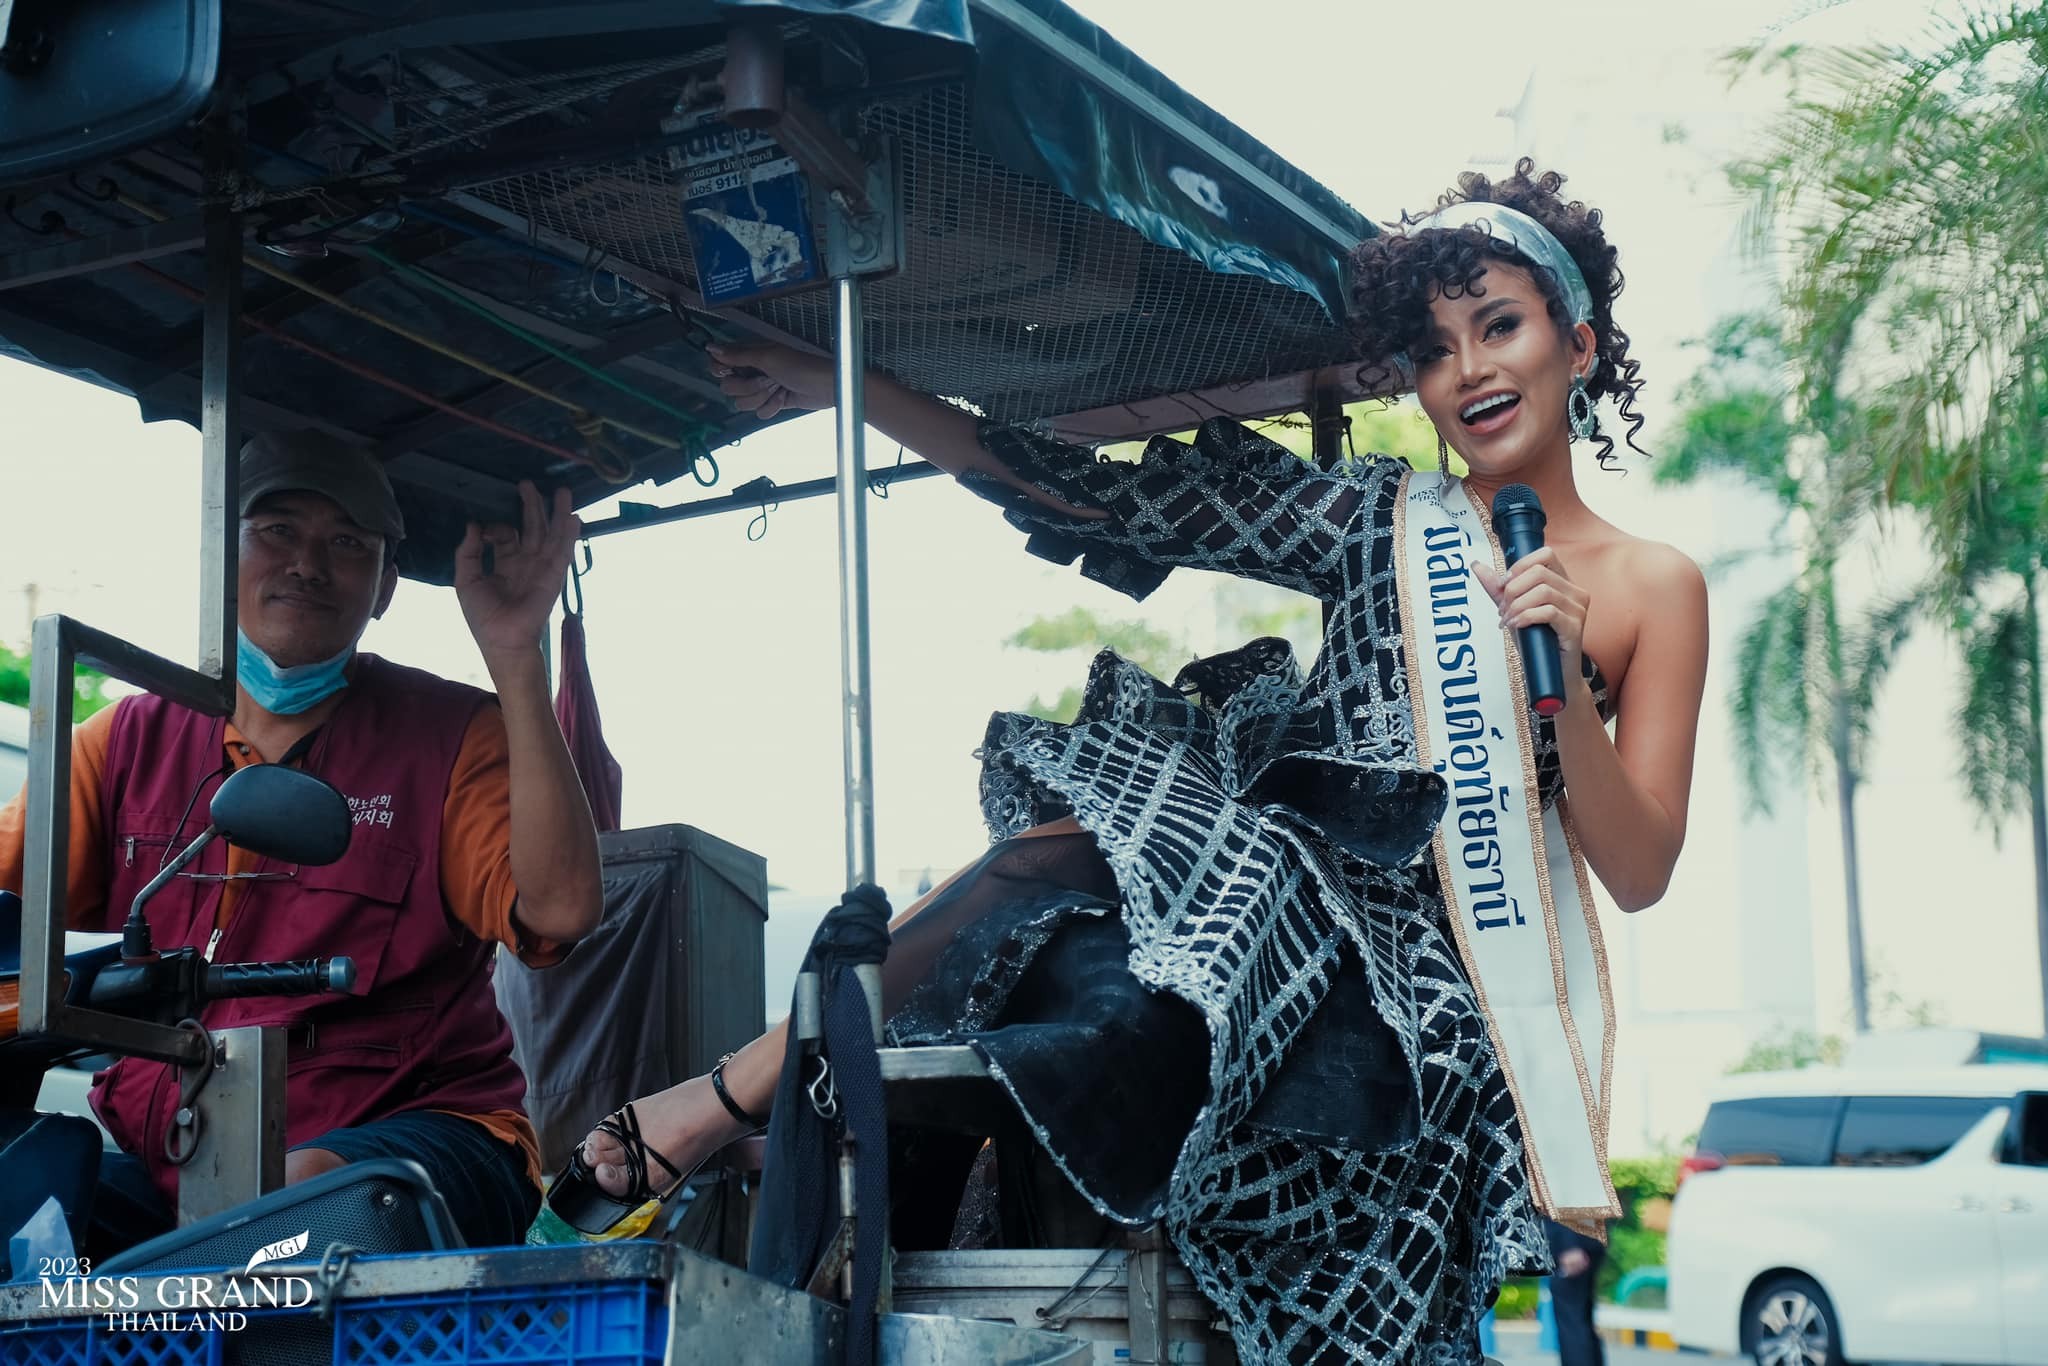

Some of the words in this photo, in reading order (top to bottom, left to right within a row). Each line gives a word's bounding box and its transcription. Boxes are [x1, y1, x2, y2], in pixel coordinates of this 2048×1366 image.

[344, 794, 392, 812] 한노인회
[1424, 523, 1526, 931] มิสแกรนด์อุทัยธานี
